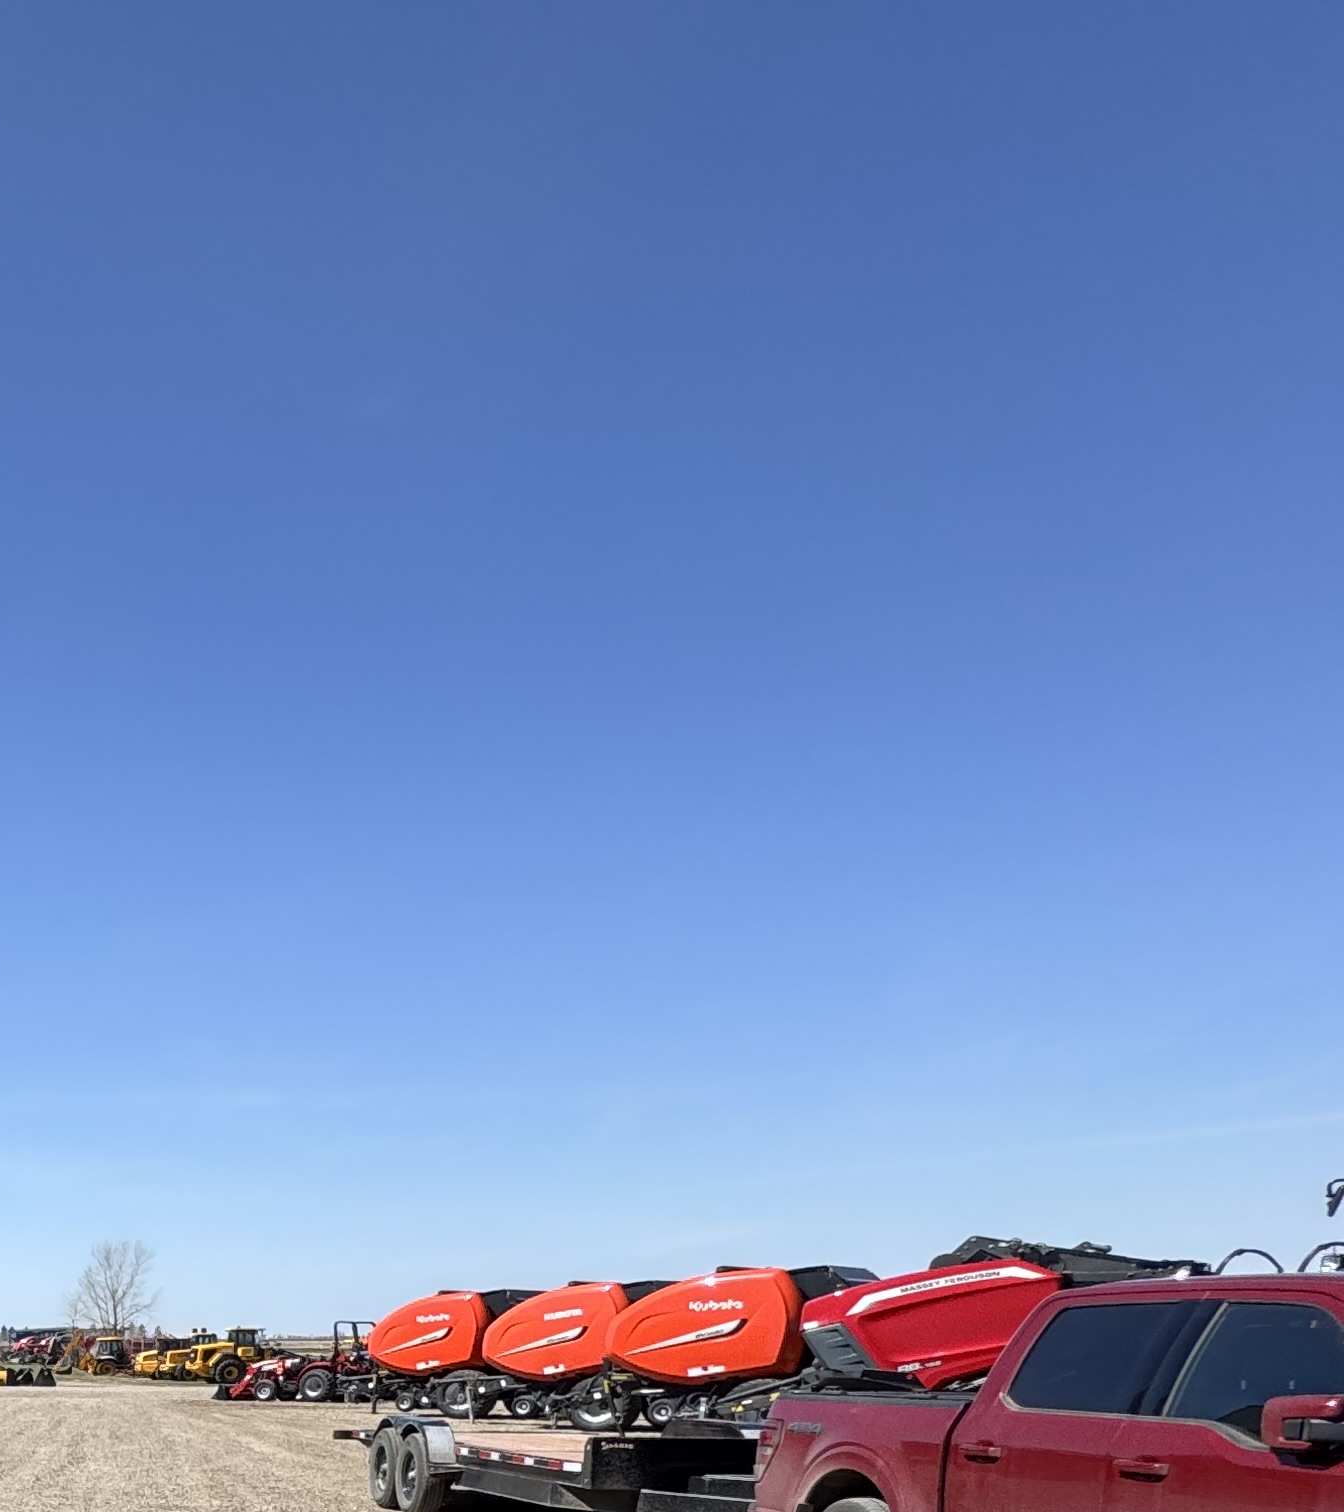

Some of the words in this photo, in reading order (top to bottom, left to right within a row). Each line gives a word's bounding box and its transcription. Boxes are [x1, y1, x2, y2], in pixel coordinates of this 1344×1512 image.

[900, 1280, 942, 1293] MASSEY
[943, 1270, 1001, 1286] FERGUSON
[688, 1299, 744, 1312] Kubota
